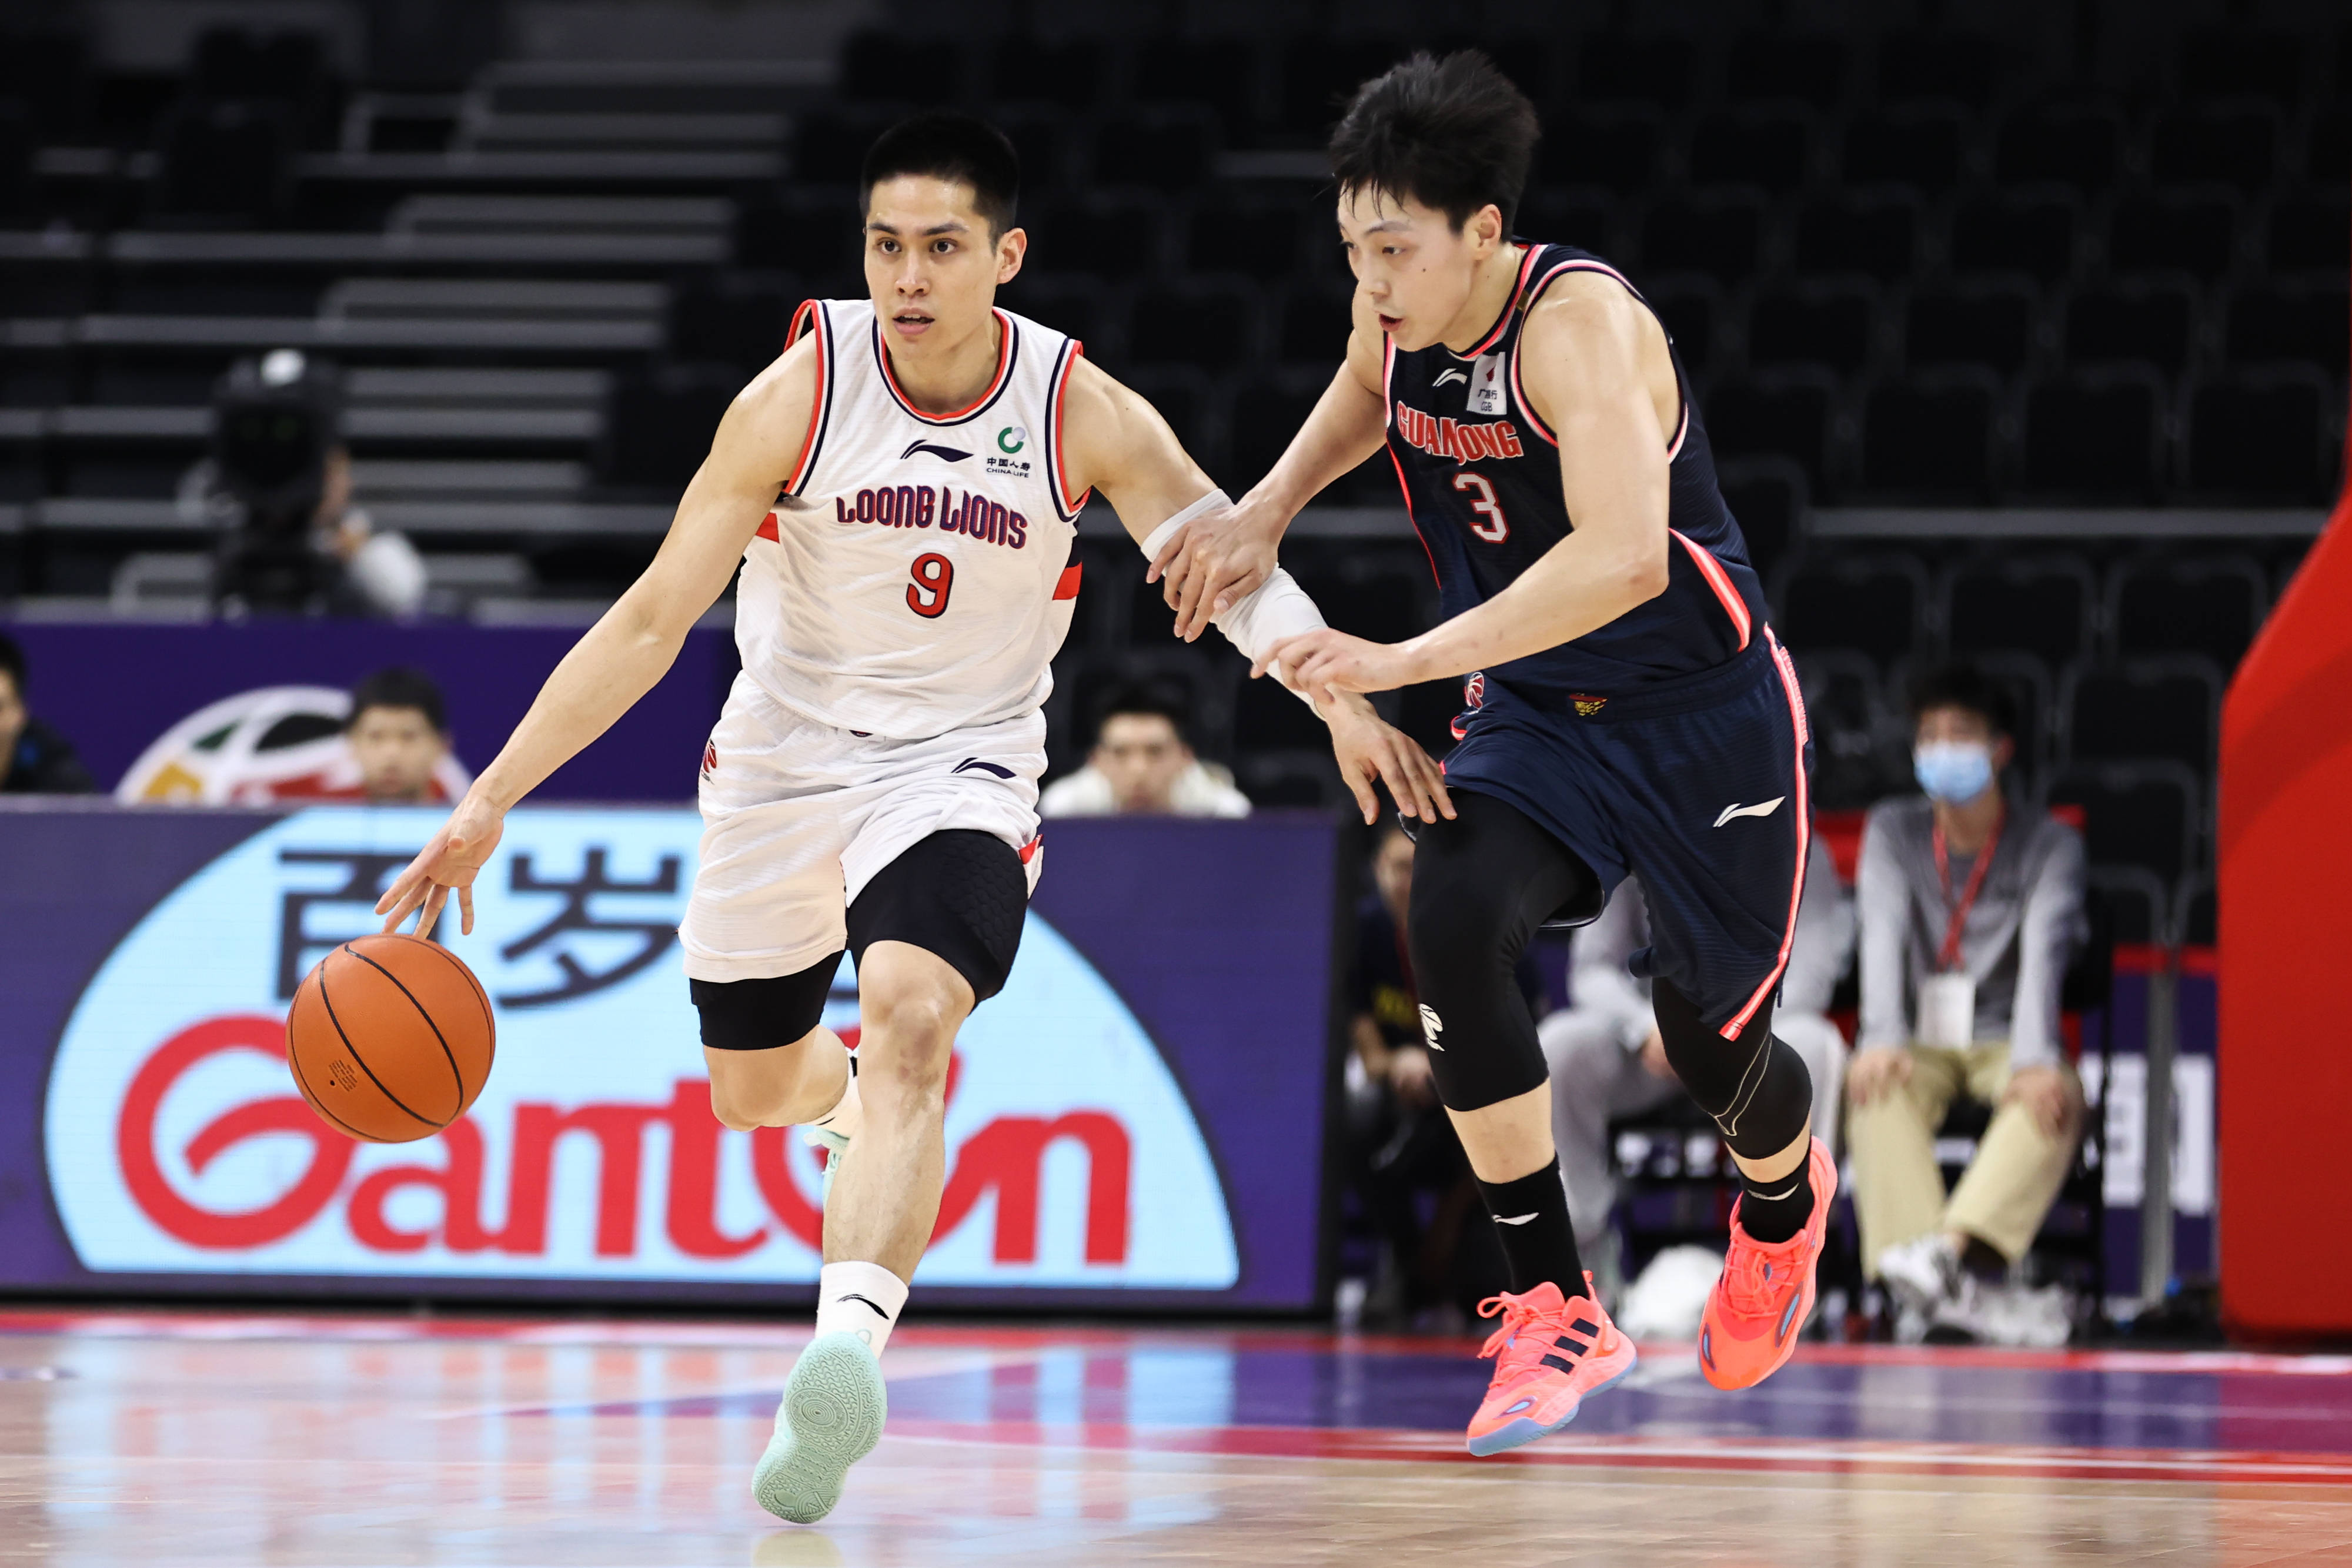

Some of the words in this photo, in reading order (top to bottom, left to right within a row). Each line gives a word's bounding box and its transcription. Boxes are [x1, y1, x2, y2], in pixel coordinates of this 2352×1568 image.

[987, 457, 1031, 472] 中国人寿
[836, 484, 936, 529] LOONG
[939, 486, 1028, 550] LIONS
[1452, 472, 1510, 544] 3
[906, 552, 954, 619] 9
